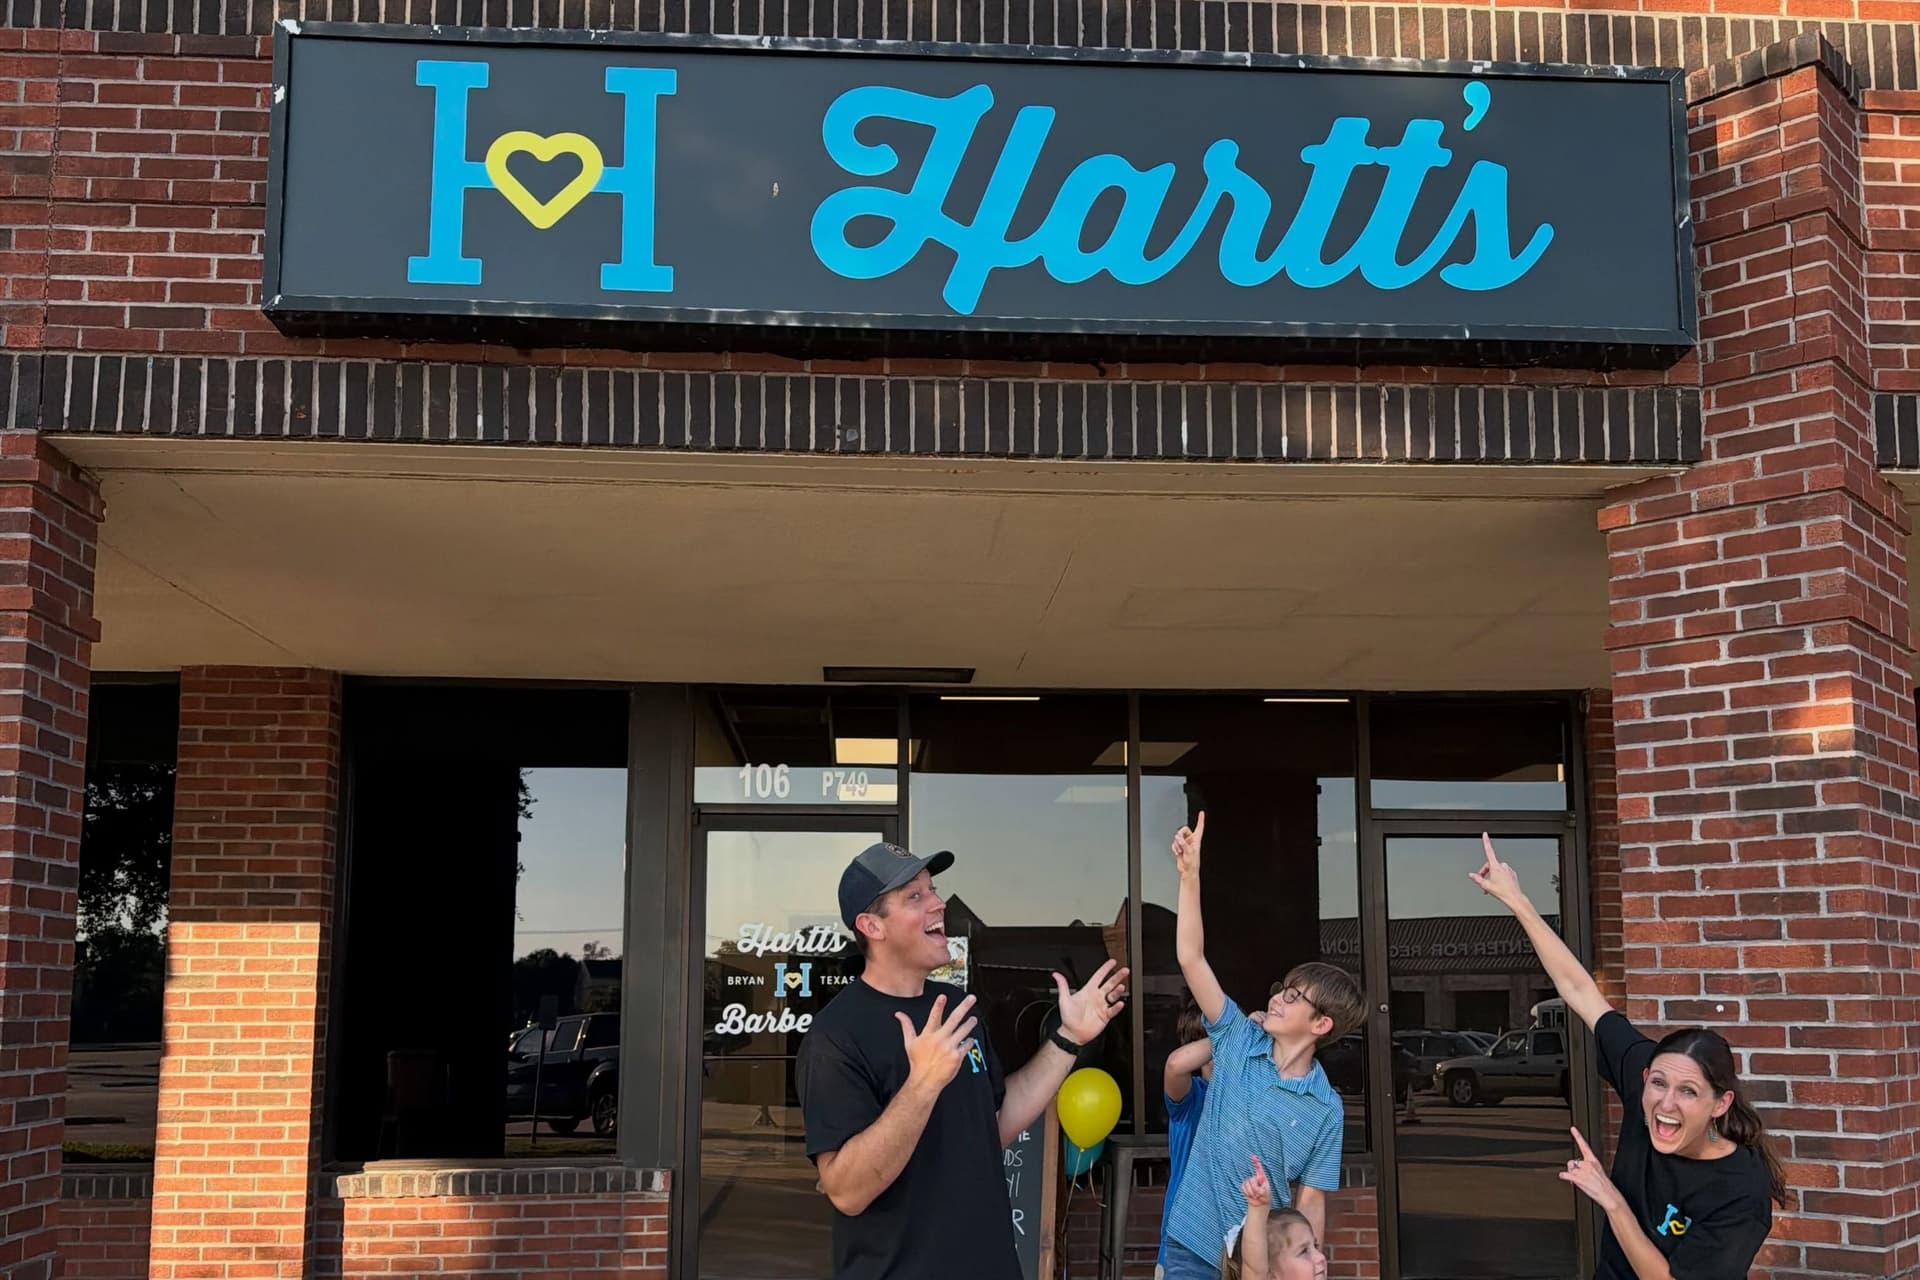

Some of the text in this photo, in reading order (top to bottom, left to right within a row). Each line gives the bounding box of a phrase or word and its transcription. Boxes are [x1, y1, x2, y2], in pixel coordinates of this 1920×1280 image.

[810, 81, 1554, 315] Hartt's
[739, 763, 790, 798] 106
[822, 771, 868, 797] P749
[738, 922, 847, 958] Hartt's
[727, 976, 765, 986] BRYAN
[820, 975, 855, 985] TEXAS
[715, 1003, 813, 1035] Barbe
